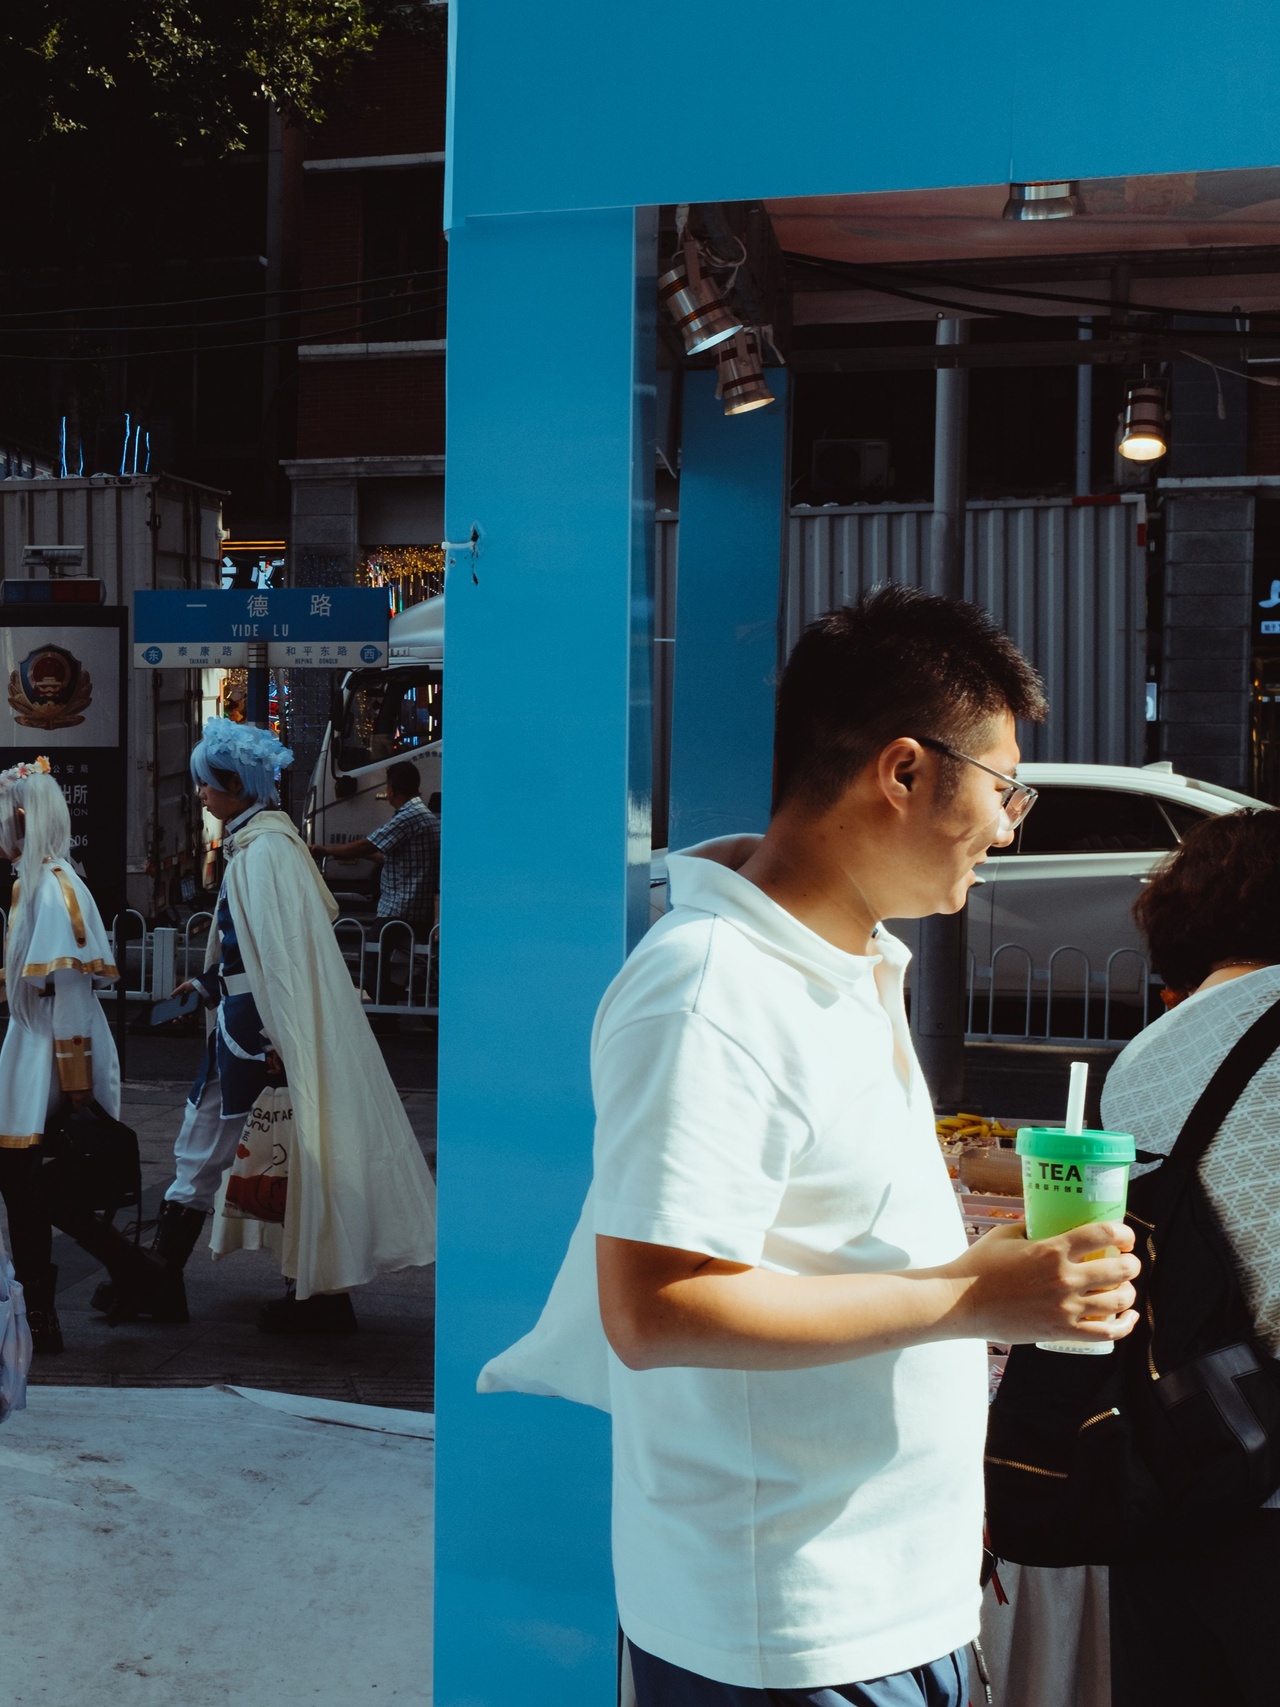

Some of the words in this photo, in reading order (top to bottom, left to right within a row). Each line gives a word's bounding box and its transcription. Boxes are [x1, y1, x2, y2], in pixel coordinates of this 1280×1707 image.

[186, 594, 333, 618] 一德路
[231, 624, 259, 637] YIDE
[273, 624, 289, 637] LU
[148, 649, 160, 662] 东
[178, 646, 232, 657] 泰康路
[285, 646, 348, 657] 和平东路
[363, 648, 376, 661] 西
[53, 764, 89, 774] 公安局
[1038, 1162, 1082, 1182] TEA
